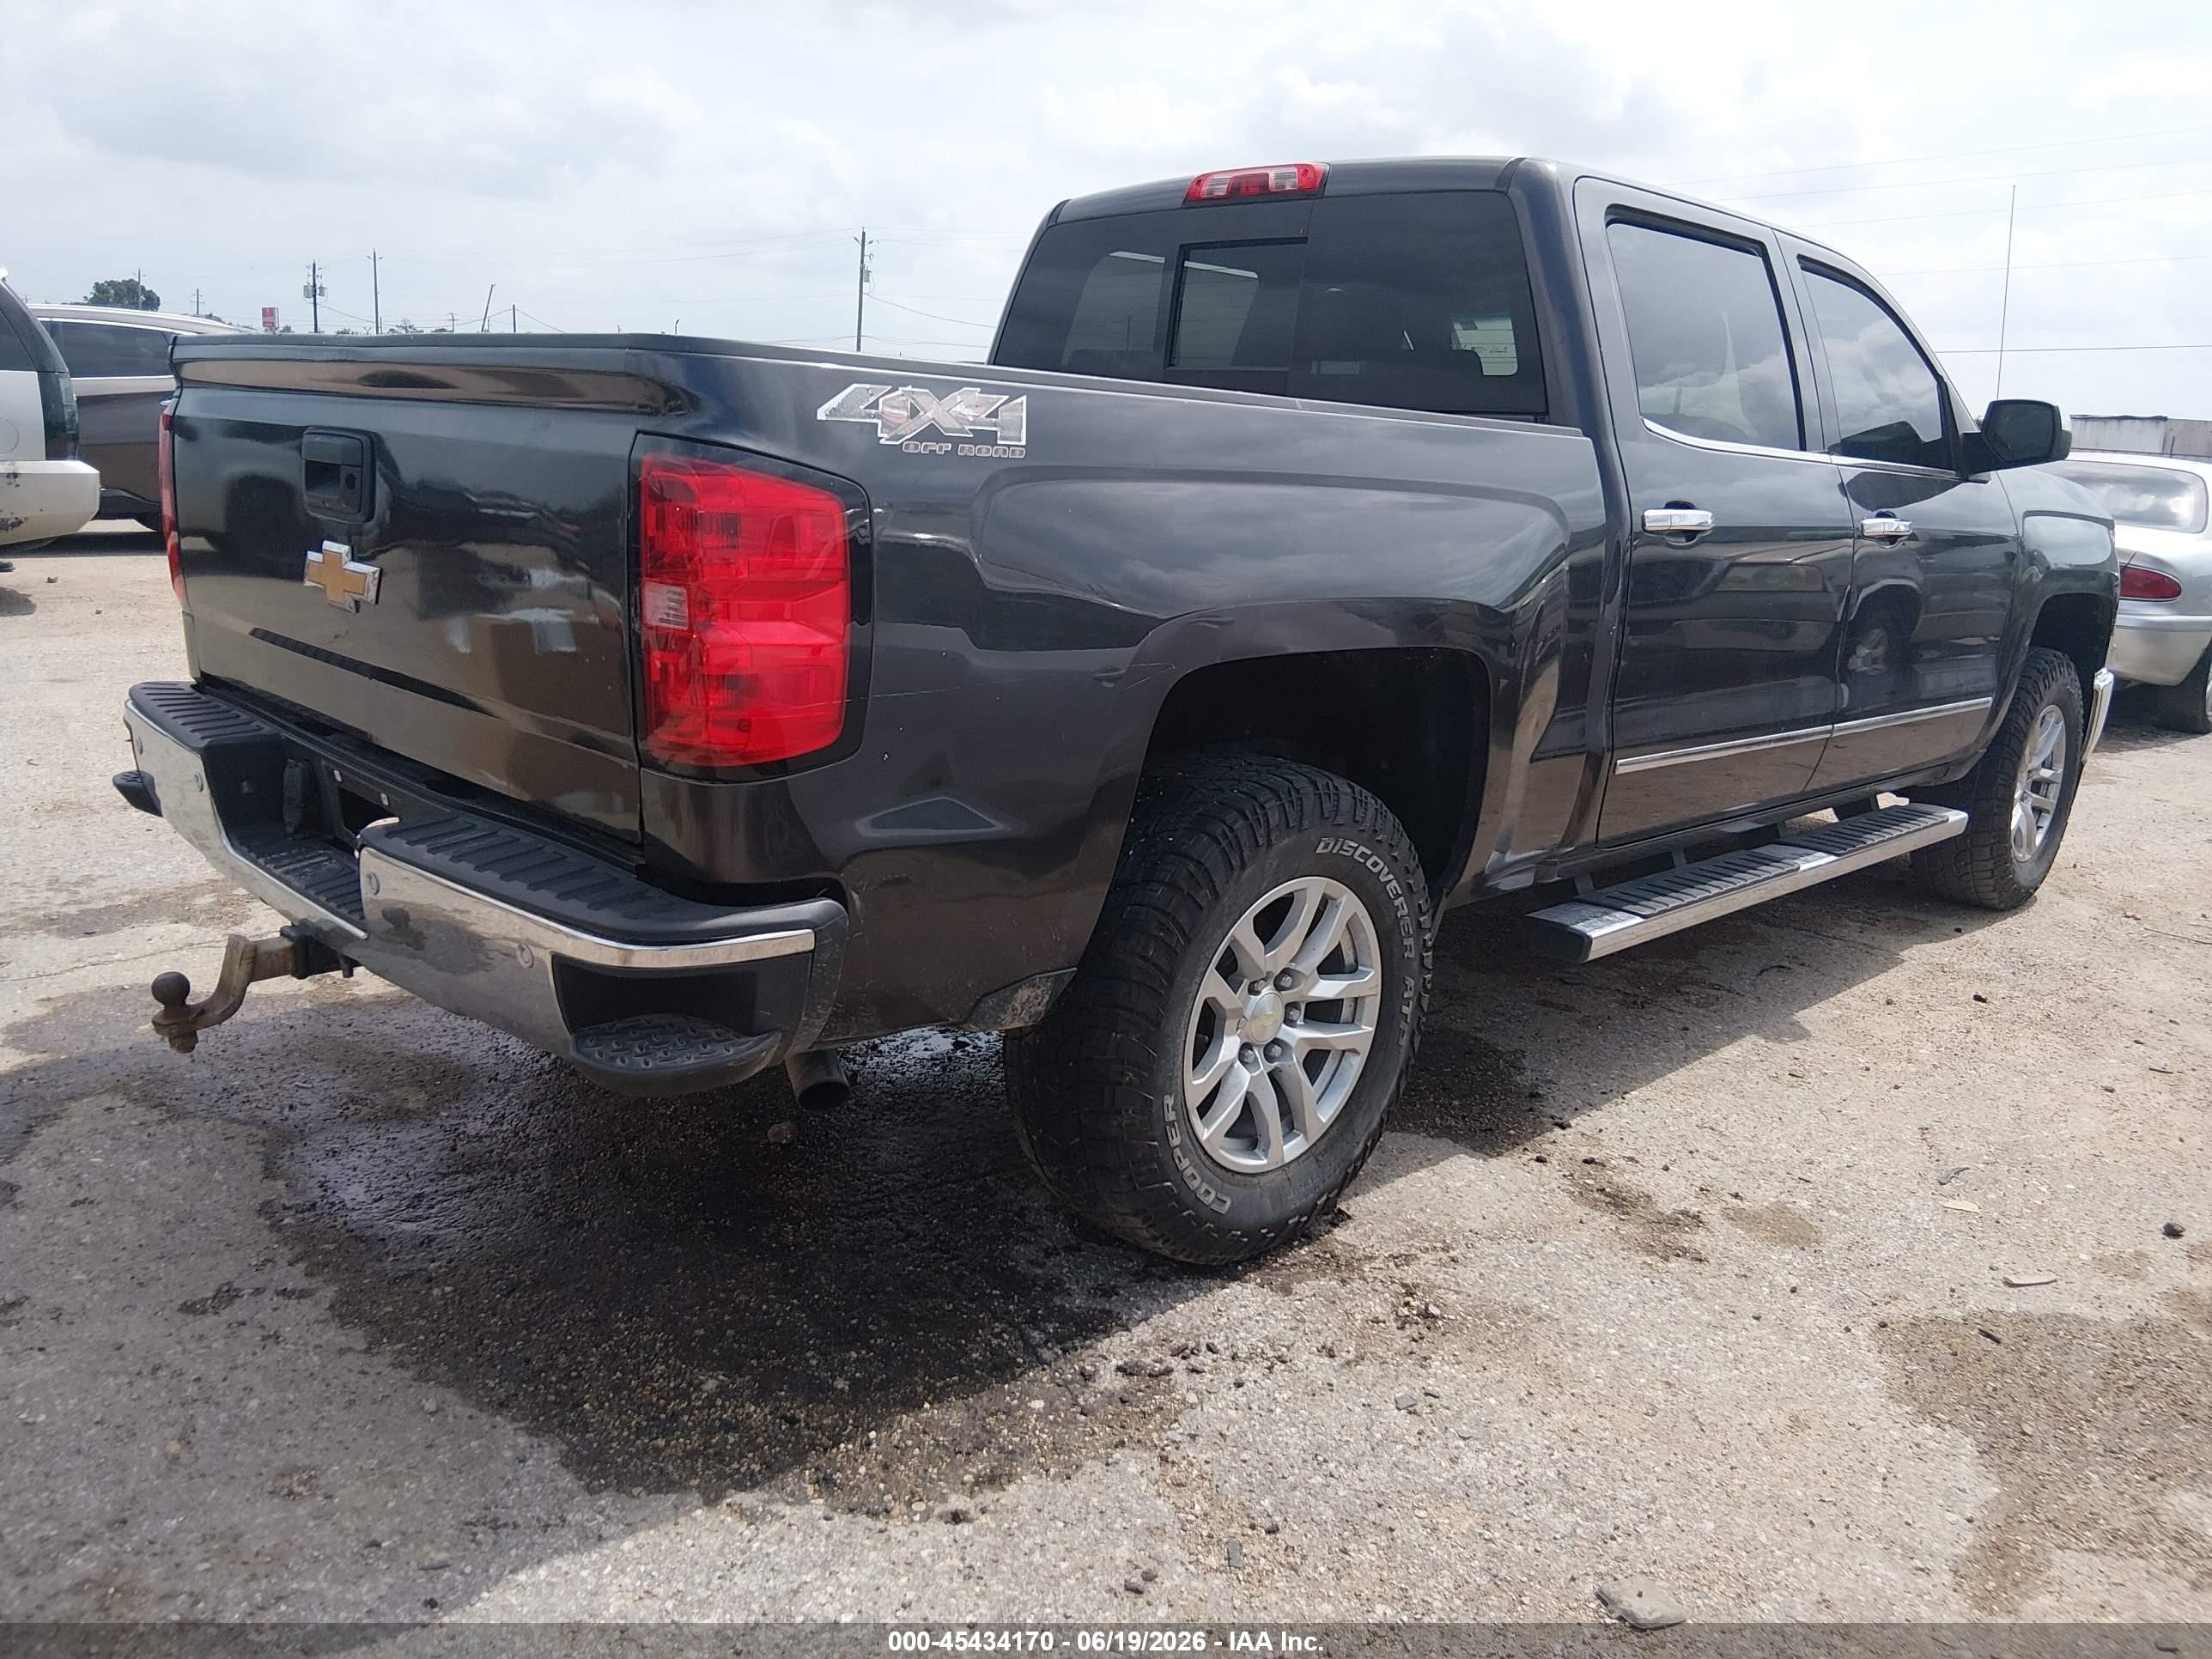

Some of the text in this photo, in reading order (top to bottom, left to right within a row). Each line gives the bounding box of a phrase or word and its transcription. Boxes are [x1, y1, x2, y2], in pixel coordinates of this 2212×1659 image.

[902, 441, 1026, 458] OFF ROAD
[1316, 837, 1415, 959] DISCOVERER
[1164, 1093, 1231, 1214] COOPER
